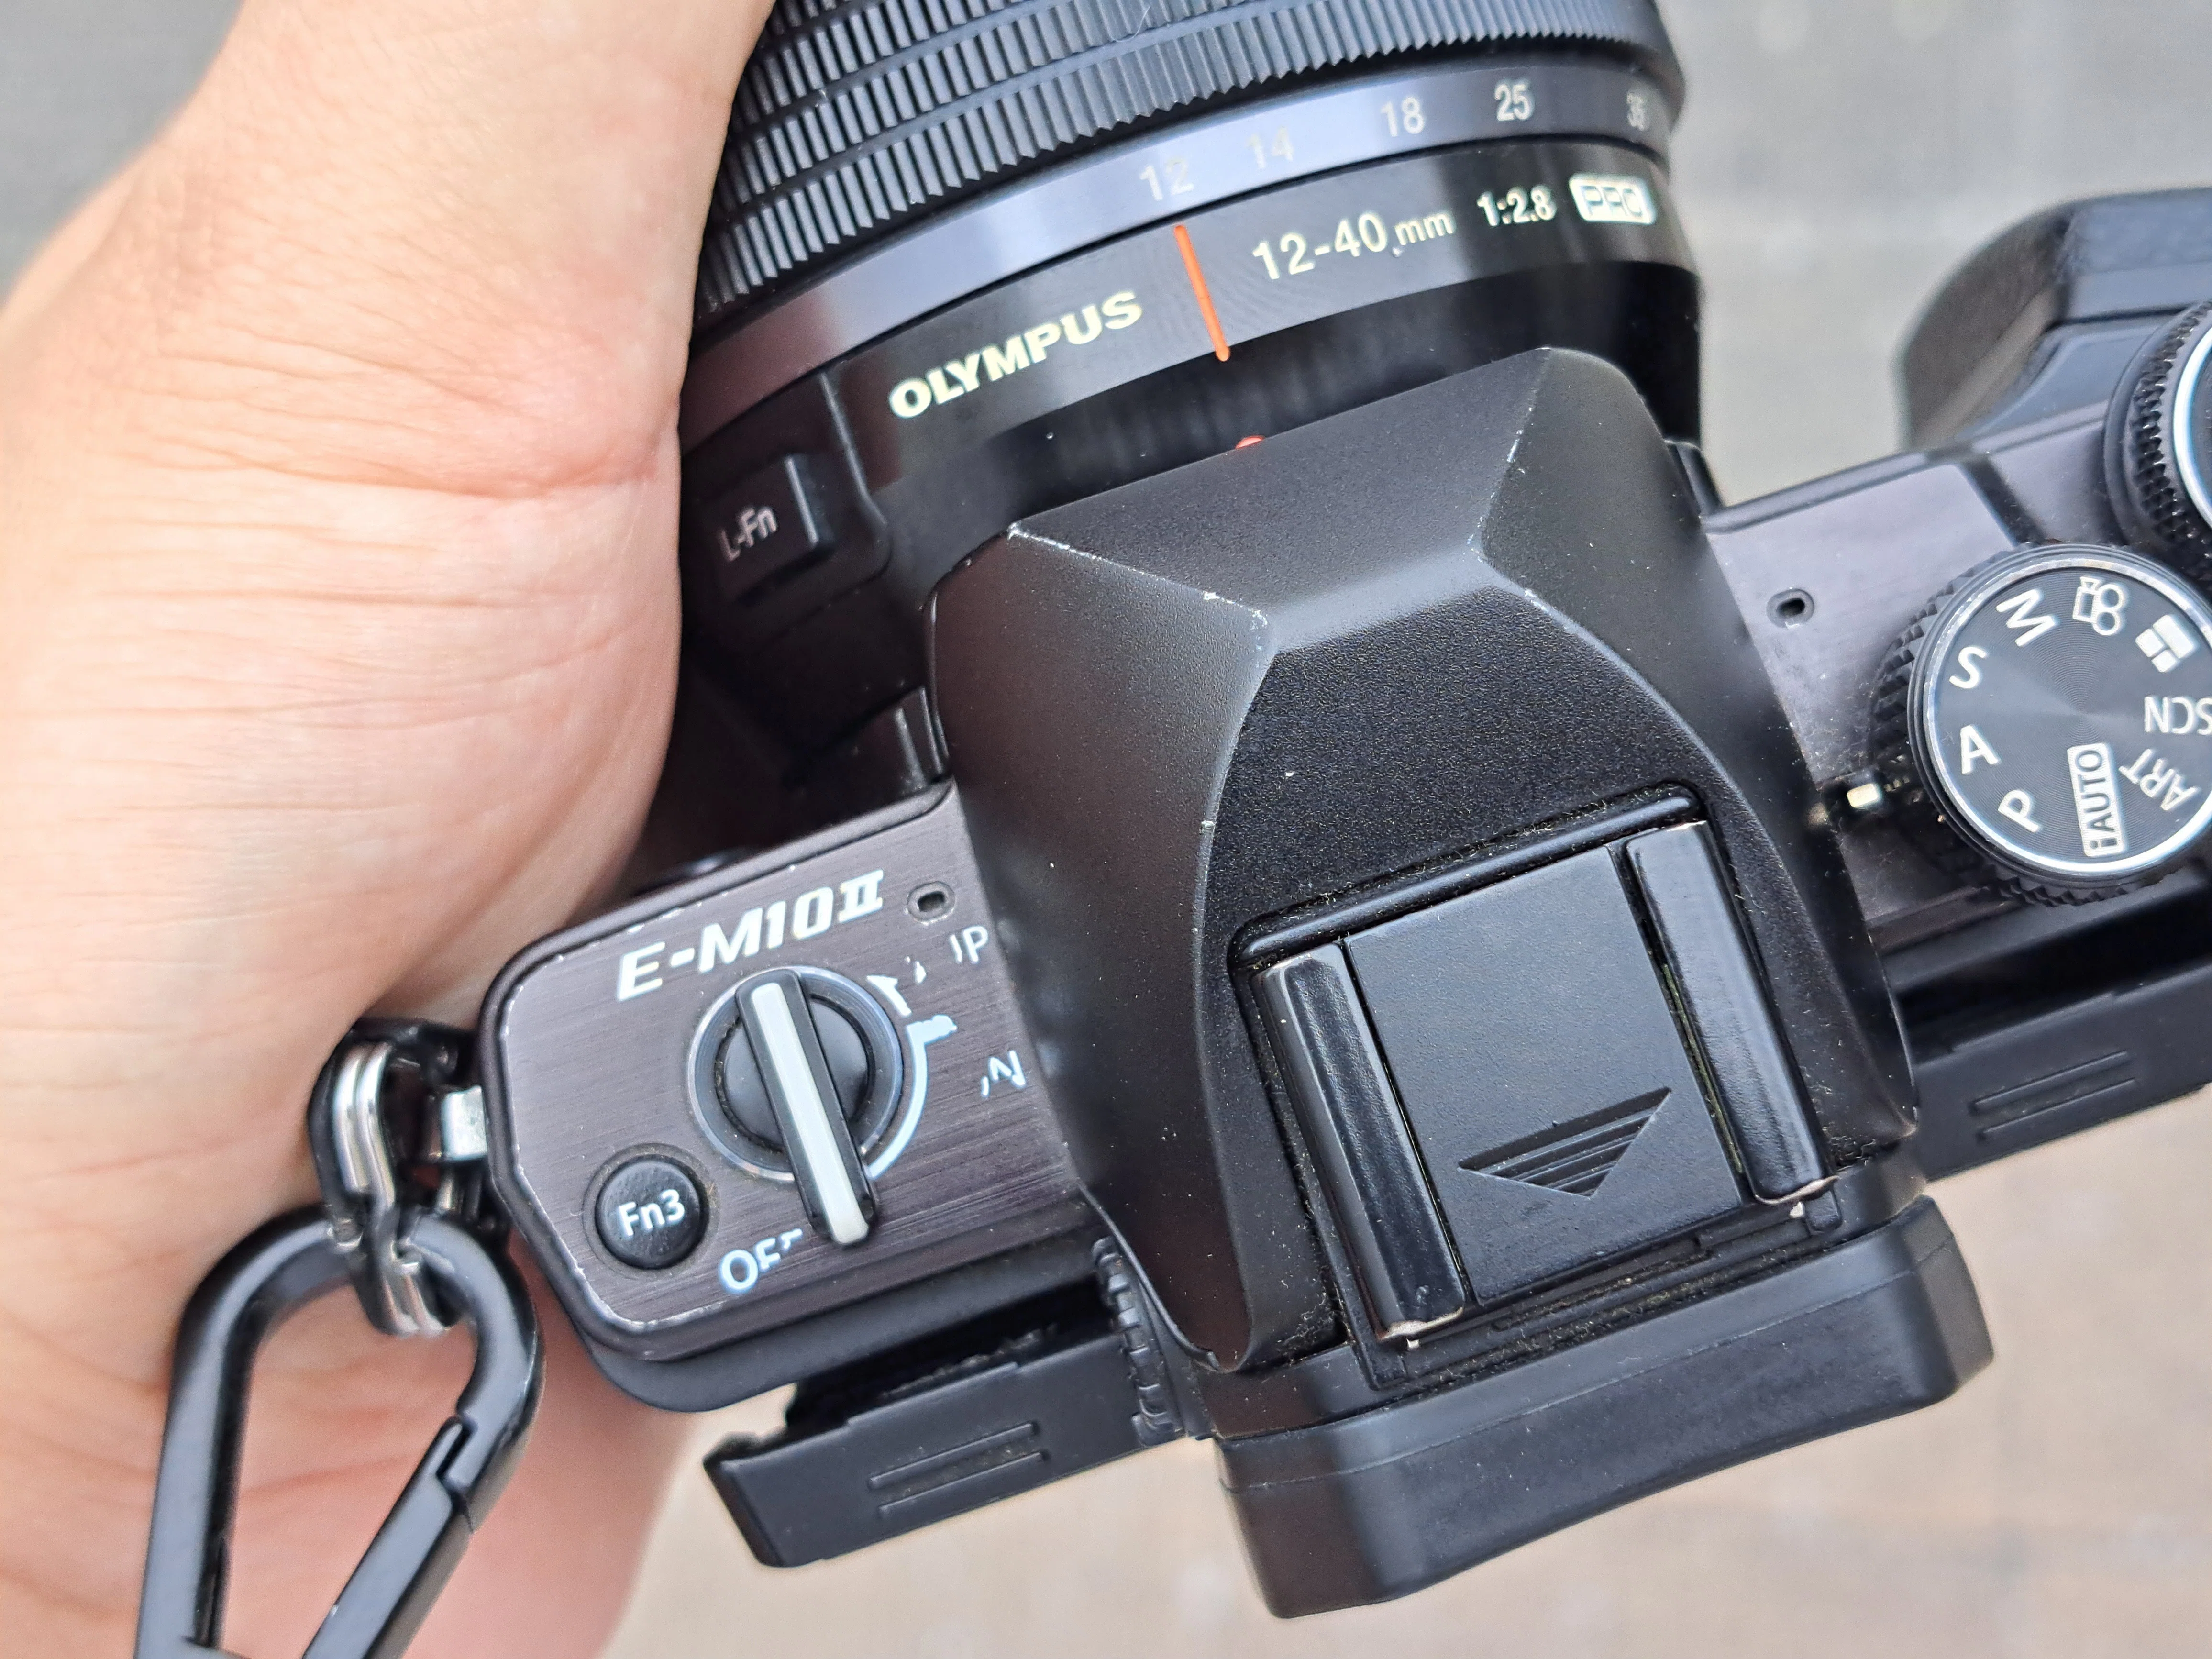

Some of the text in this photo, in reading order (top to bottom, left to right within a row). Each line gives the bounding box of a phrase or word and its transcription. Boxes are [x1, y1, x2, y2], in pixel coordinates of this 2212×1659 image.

[1381, 96, 1426, 137] 18
[1495, 80, 1533, 122] 25
[1246, 124, 1294, 168] 14
[1139, 156, 1195, 201] 12
[1477, 184, 1557, 227] 1:2.8
[890, 291, 1143, 418] OLYMPUS
[719, 506, 777, 561] L-Fn
[1996, 588, 2056, 647] M
[1949, 646, 1989, 689] S
[1961, 724, 2001, 774] A
[2118, 748, 2198, 811] ART
[1997, 789, 2040, 833] P
[980, 1050, 1027, 1097] N
[618, 1188, 685, 1237] Fn3
